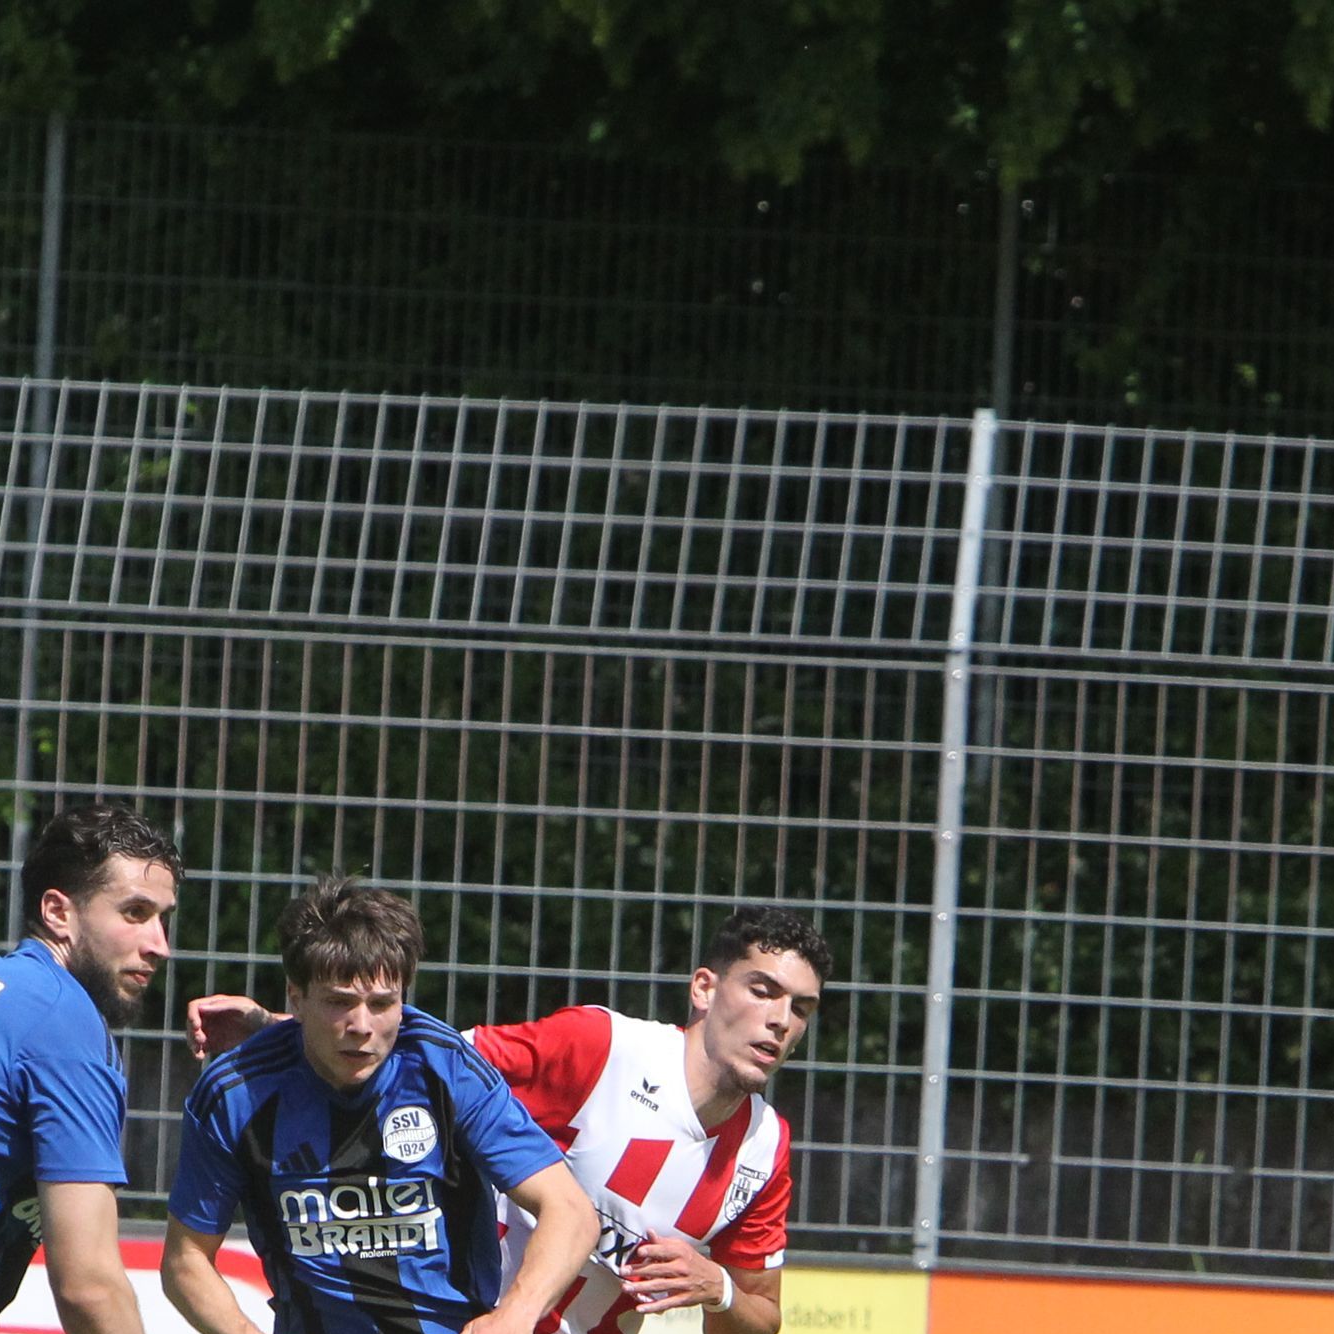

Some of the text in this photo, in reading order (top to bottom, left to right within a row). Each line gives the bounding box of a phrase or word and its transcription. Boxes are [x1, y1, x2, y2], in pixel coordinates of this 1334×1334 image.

[630, 1089, 660, 1112] erima
[391, 1110, 421, 1130] SSV
[398, 1142, 426, 1158] 1924
